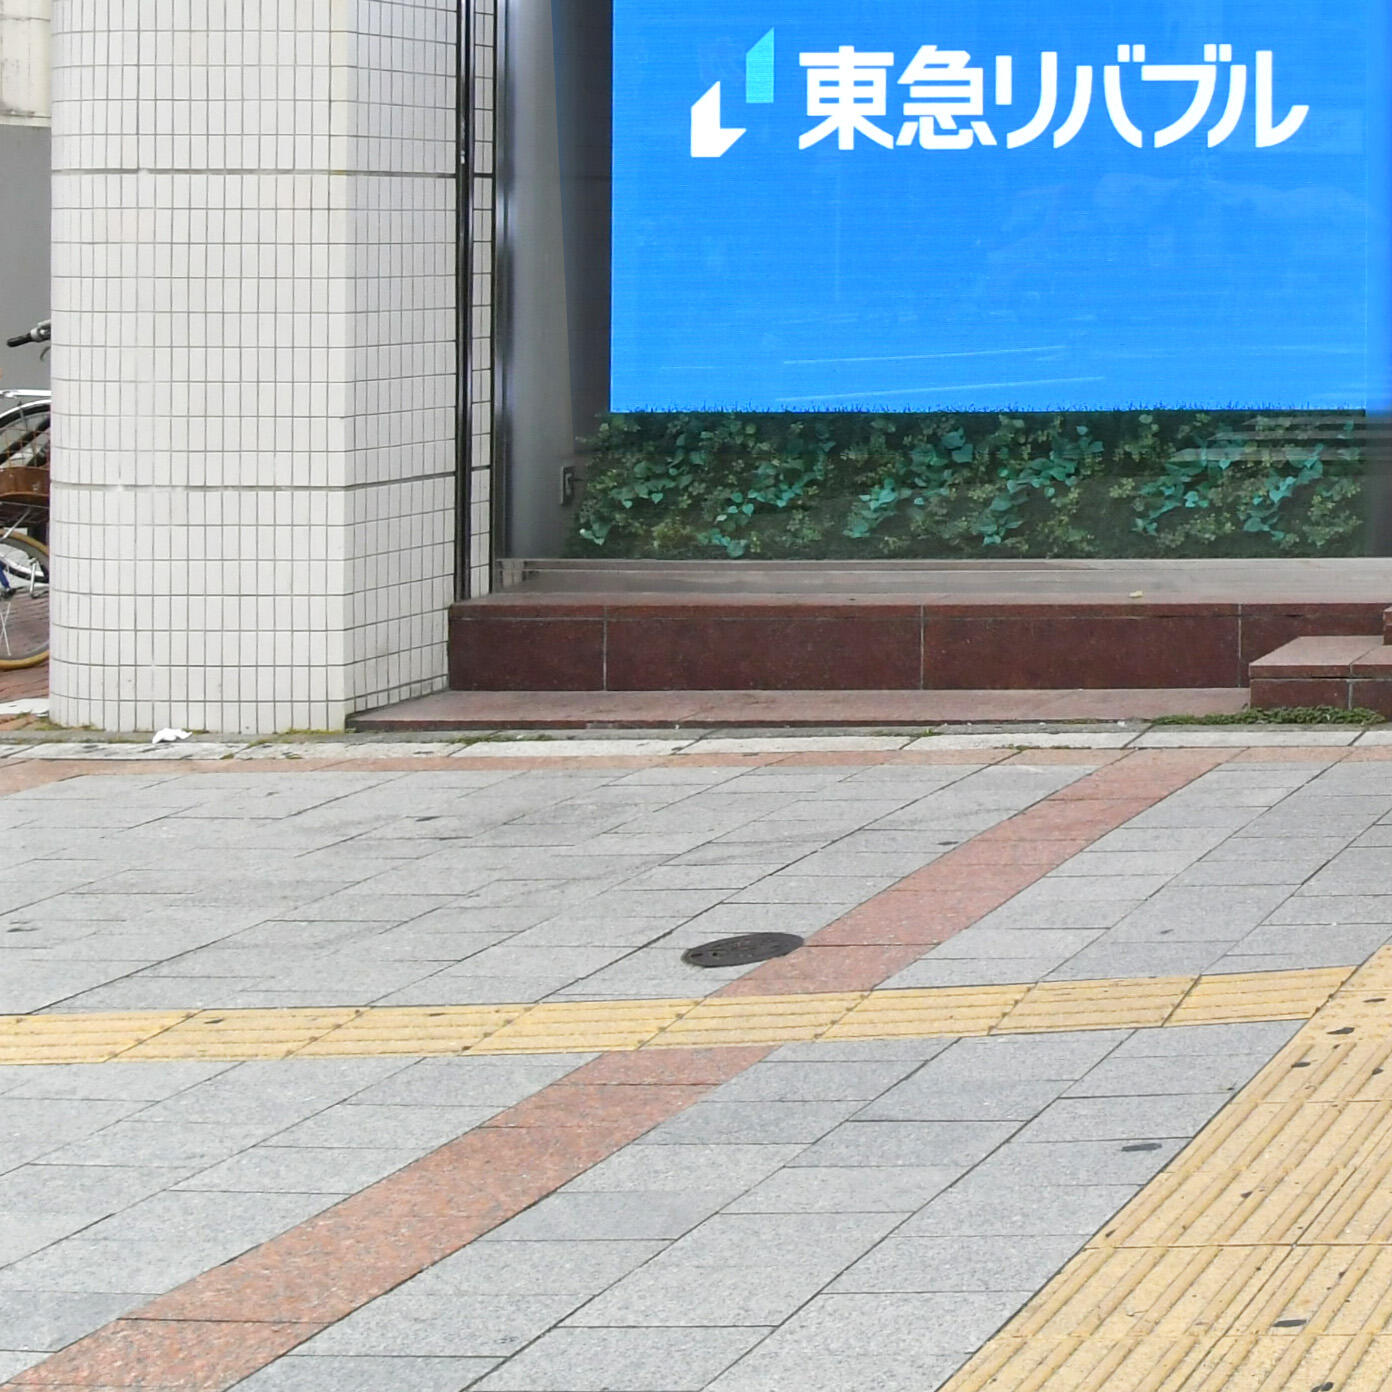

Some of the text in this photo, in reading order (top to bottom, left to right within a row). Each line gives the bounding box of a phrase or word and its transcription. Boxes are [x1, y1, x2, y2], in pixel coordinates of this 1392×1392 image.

[798, 43, 1310, 151] 東急リバブル
